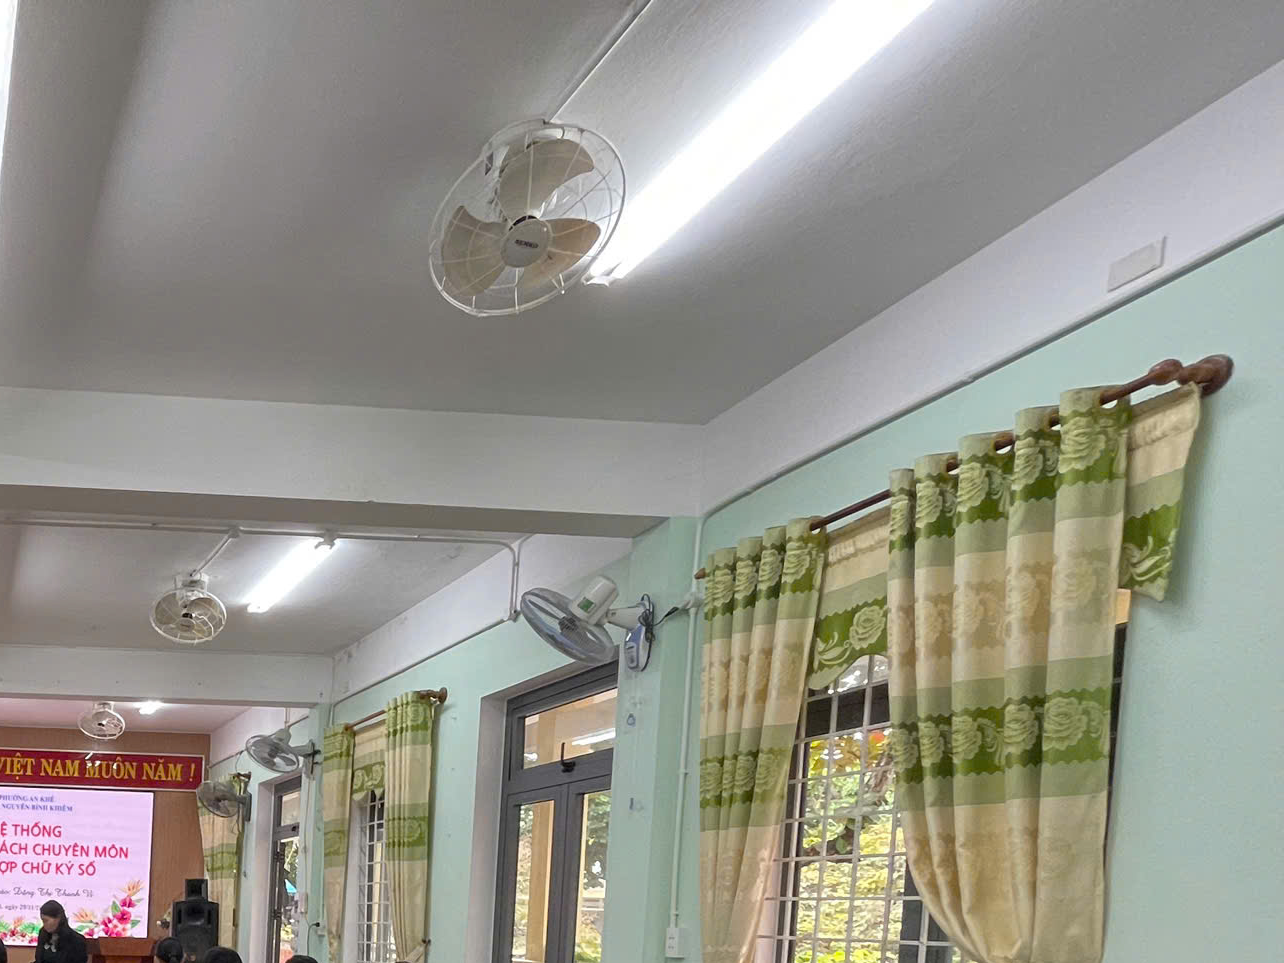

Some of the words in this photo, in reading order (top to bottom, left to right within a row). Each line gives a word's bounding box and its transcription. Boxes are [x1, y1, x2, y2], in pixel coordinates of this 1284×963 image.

[39, 758, 80, 777] NAM
[85, 756, 137, 779] MUÔN
[142, 758, 184, 782] NĂM
[11, 820, 62, 838] THỐNG
[32, 842, 90, 858] CHUYÊN
[94, 843, 129, 859] MÔN
[21, 859, 52, 875] CHỮ
[55, 860, 75, 876] KÝ
[77, 860, 97, 877] SỐ
